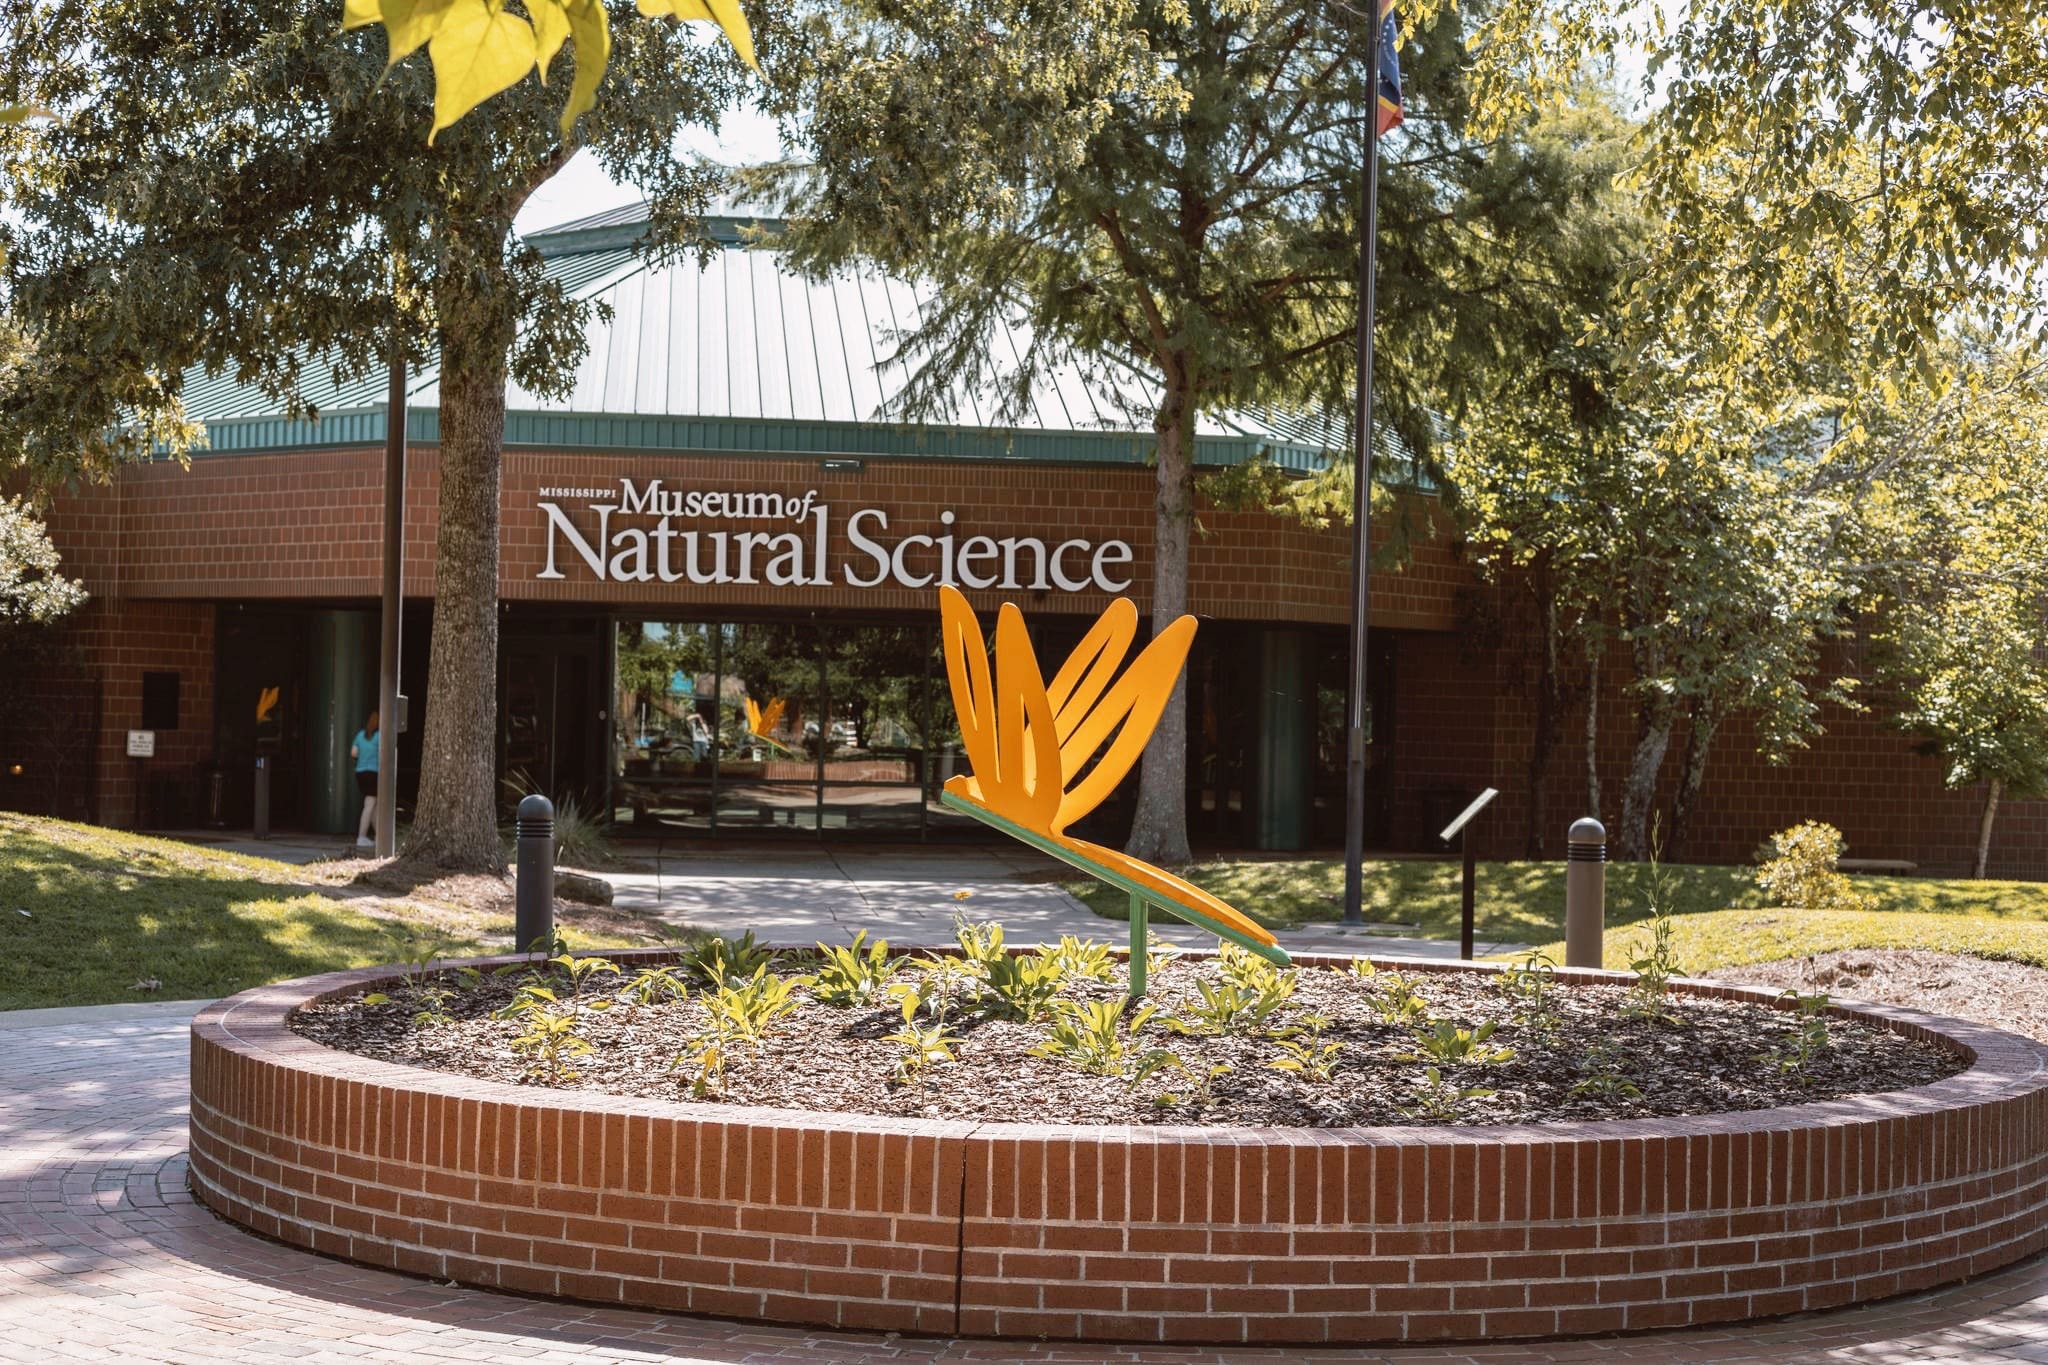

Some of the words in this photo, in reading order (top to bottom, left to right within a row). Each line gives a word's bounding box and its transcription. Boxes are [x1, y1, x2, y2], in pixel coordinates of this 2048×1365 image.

[539, 487, 617, 499] MISSISSIPPI
[618, 478, 786, 518] Museum
[785, 489, 818, 524] of
[536, 503, 833, 587] Natural
[843, 509, 1133, 593] Science
